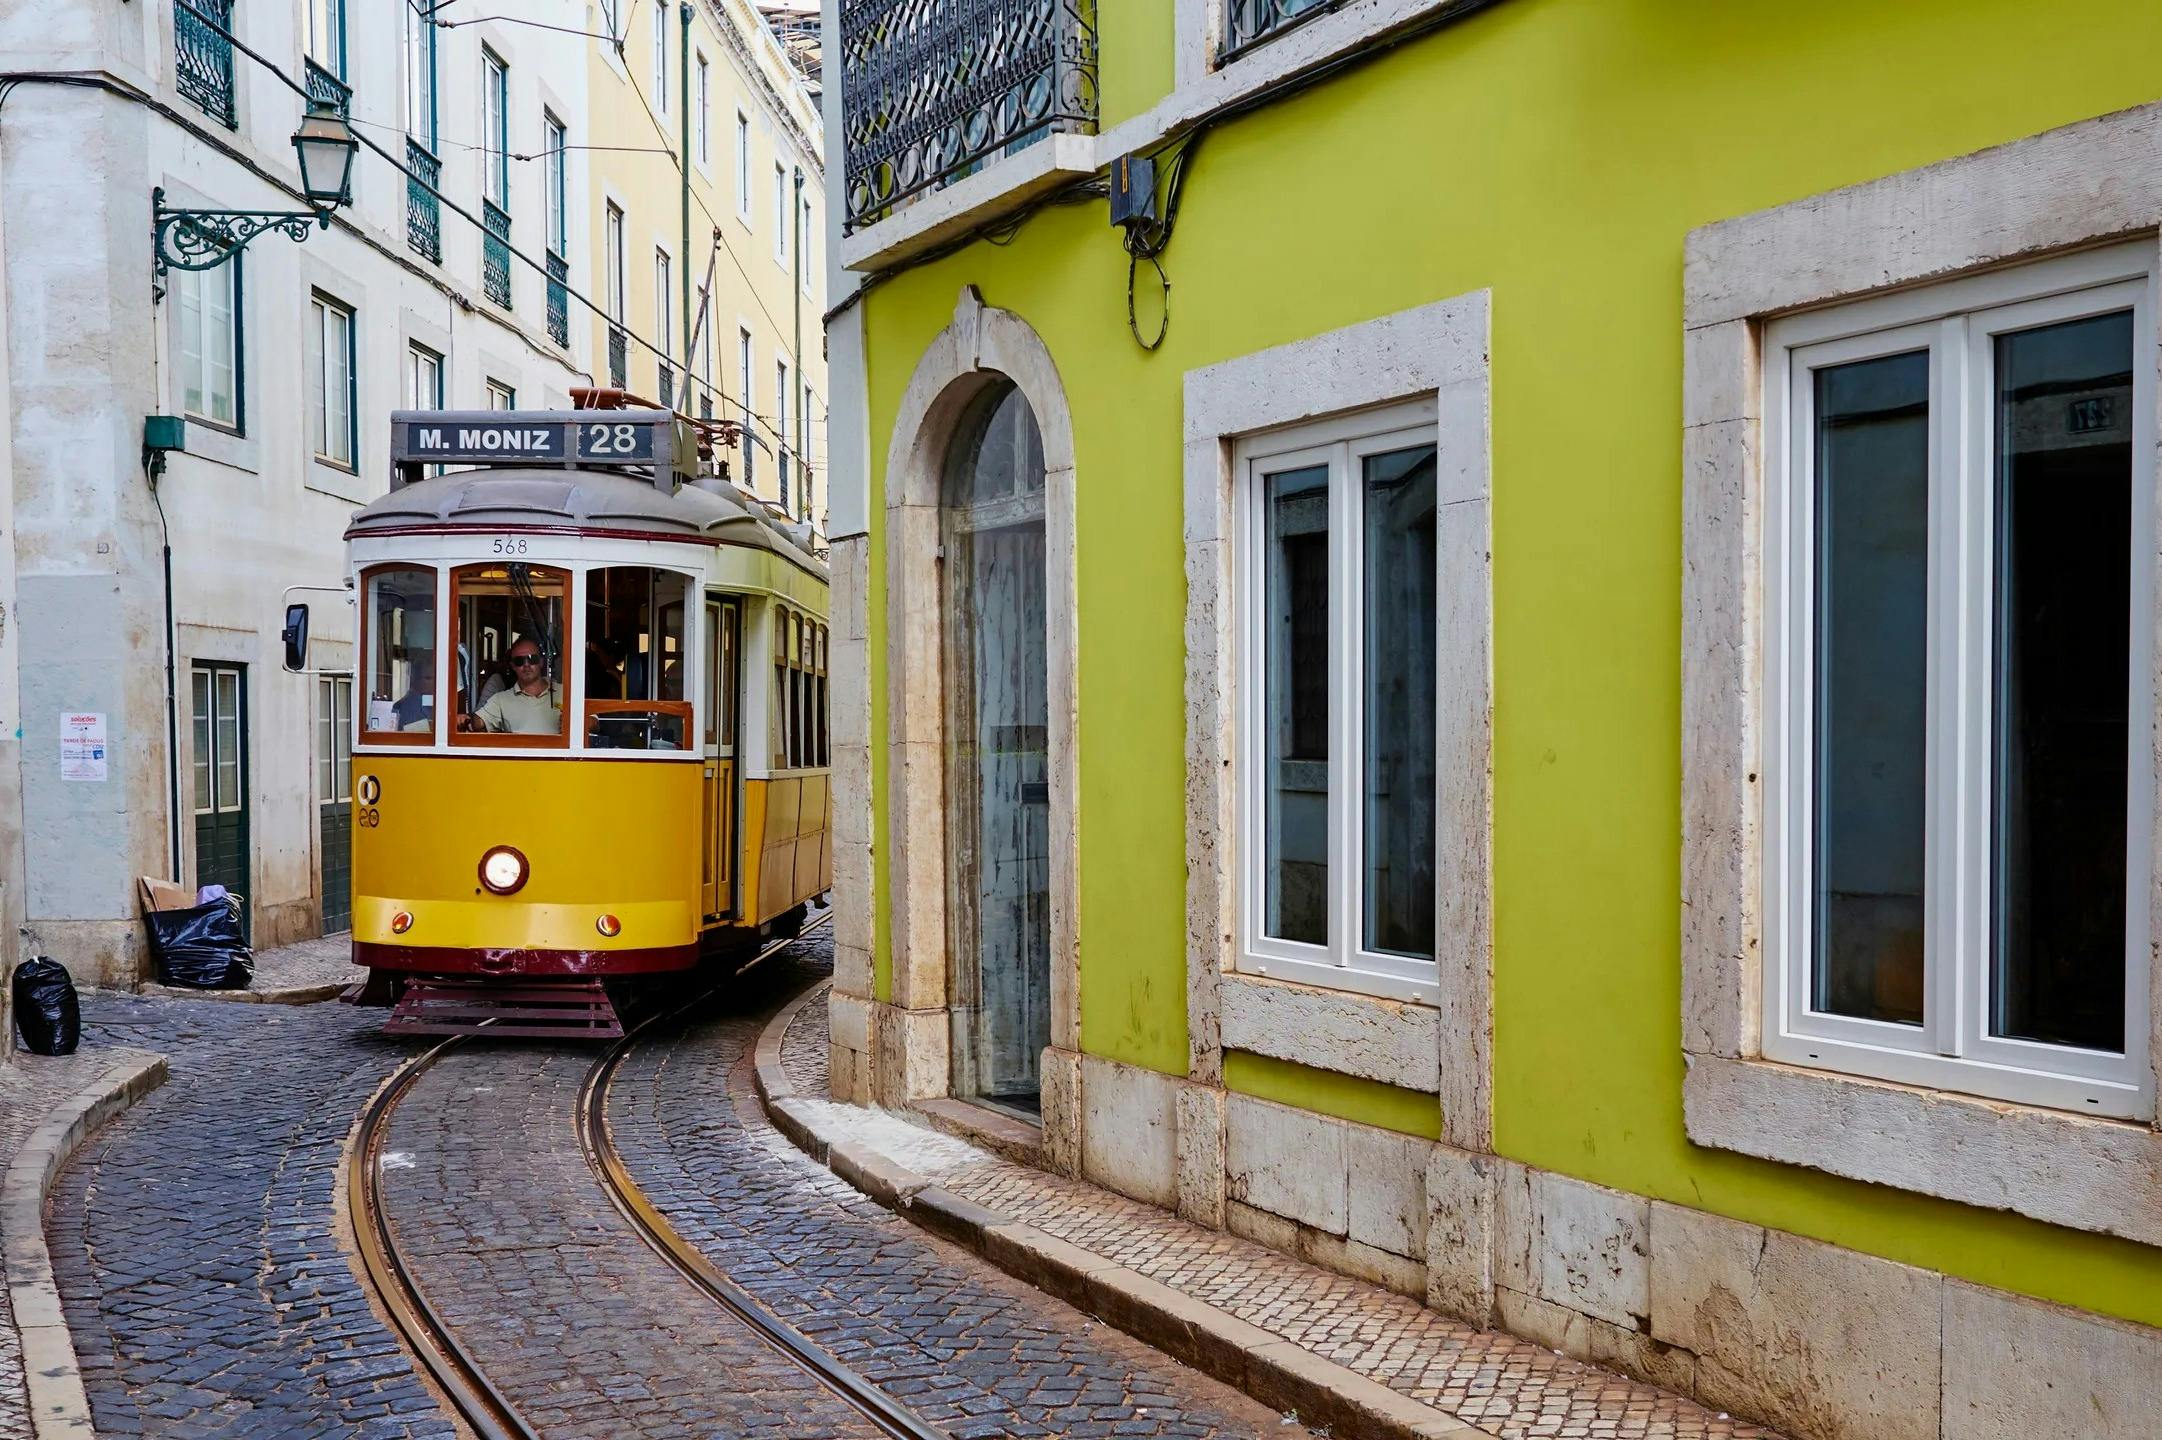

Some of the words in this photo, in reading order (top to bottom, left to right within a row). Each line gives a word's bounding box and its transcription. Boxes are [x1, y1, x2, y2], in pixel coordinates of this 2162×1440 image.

[419, 429, 450, 449] M.
[458, 429, 551, 450] MONIZ
[589, 424, 637, 453] 28
[493, 539, 527, 554] 568
